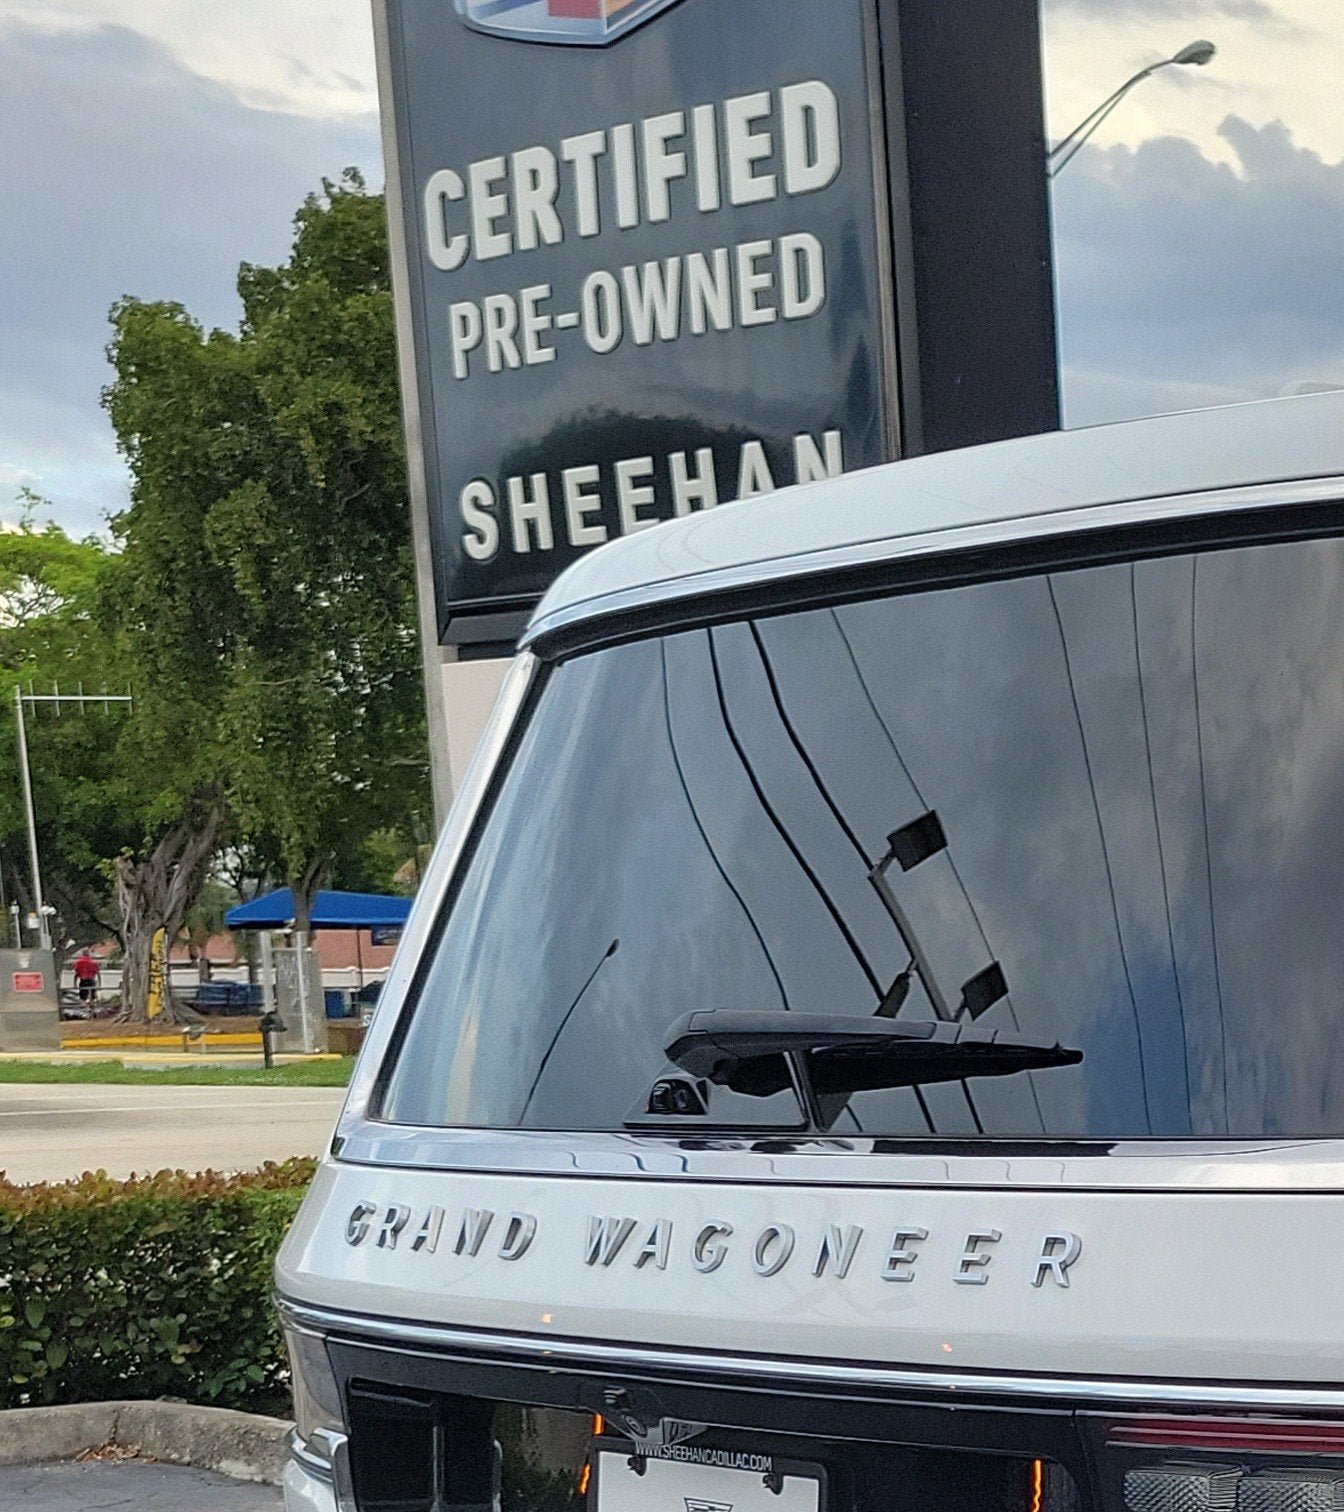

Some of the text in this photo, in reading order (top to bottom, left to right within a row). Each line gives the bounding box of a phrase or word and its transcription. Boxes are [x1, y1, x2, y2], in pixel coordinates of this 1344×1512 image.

[423, 80, 841, 272] CERTIFIED
[449, 232, 826, 380] PRE-OWNED
[460, 430, 843, 562] SHEEHAN
[343, 1199, 1082, 1289] GRAND WAGONEER
[635, 1440, 773, 1472] WWW.SHEEHANCADILLAC.COM
